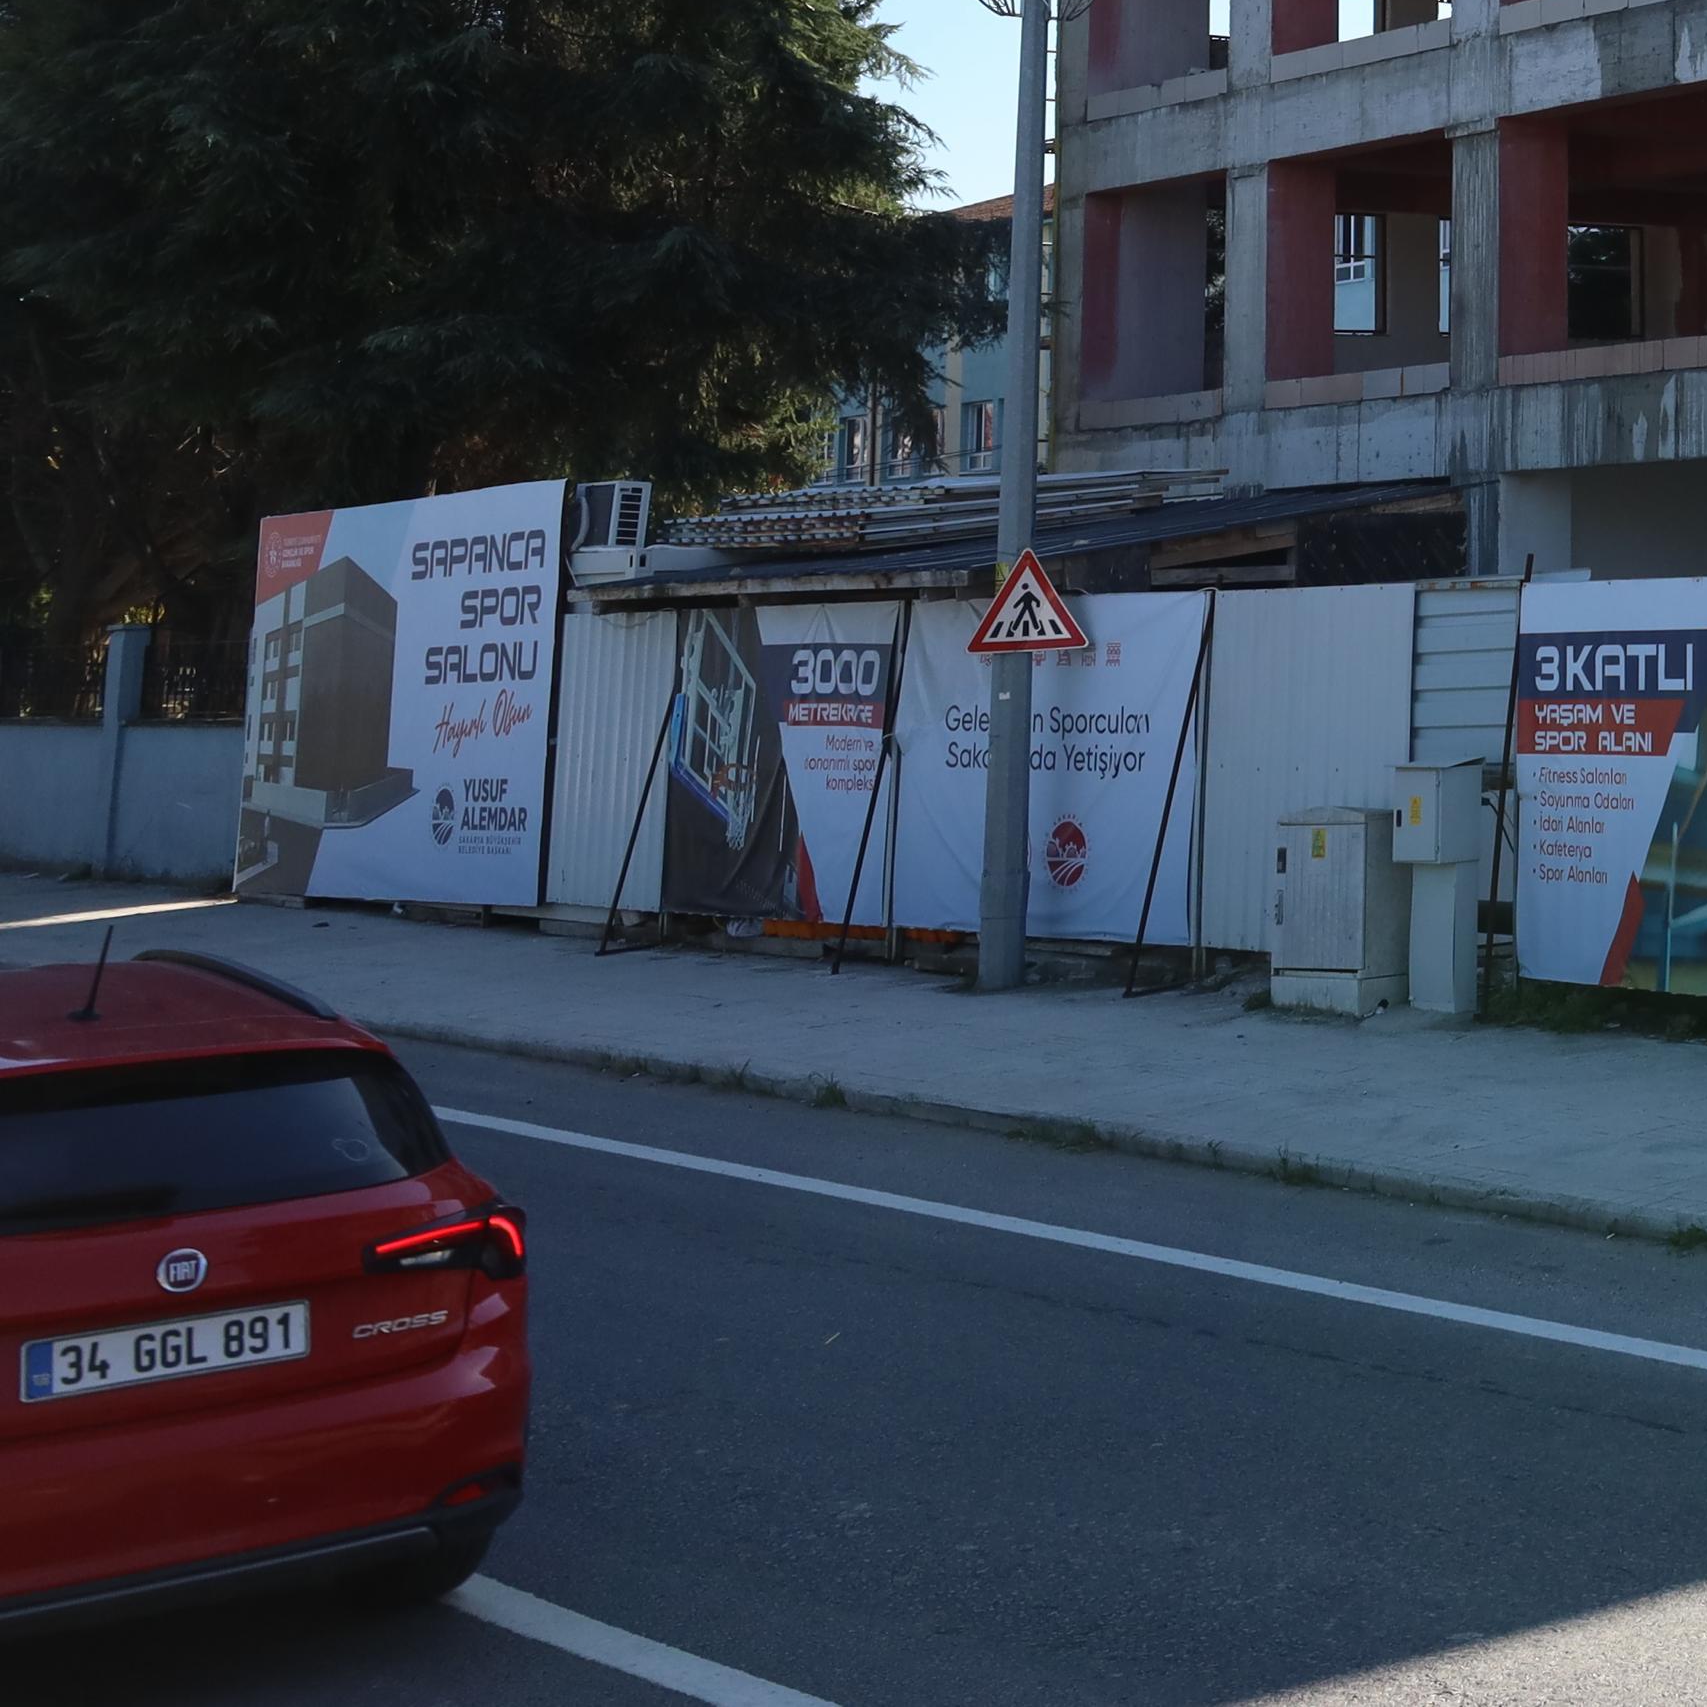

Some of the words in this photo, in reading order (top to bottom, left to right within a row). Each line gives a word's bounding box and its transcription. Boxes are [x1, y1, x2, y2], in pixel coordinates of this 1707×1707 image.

[411, 529, 546, 581] SAPANCA
[460, 584, 542, 629] SPOR
[424, 640, 539, 685] SALONU
[790, 648, 881, 696] 3000
[432, 698, 488, 758] Hayırlı
[493, 688, 533, 738] Olsun
[1534, 703, 1603, 727] YAŞAM
[1611, 703, 1636, 725] VE
[825, 734, 862, 752] Modern
[1534, 730, 1587, 752] SPOR
[1598, 731, 1653, 753] ALANI
[1063, 743, 1145, 780] Yetişiyor
[825, 774, 875, 794] kompleks
[1539, 766, 1578, 784] Fitness
[463, 778, 509, 803] YUSUF
[1539, 790, 1591, 811] Soyunma
[460, 806, 528, 832] ALEMDAR
[1539, 839, 1593, 863] Kafeterya
[1539, 863, 1564, 884] Spor
[169, 1259, 198, 1283] FIAT
[352, 1310, 449, 1339] CROSS
[59, 1340, 111, 1386] 34
[134, 1329, 208, 1373] GGL
[222, 1312, 292, 1360] 891
